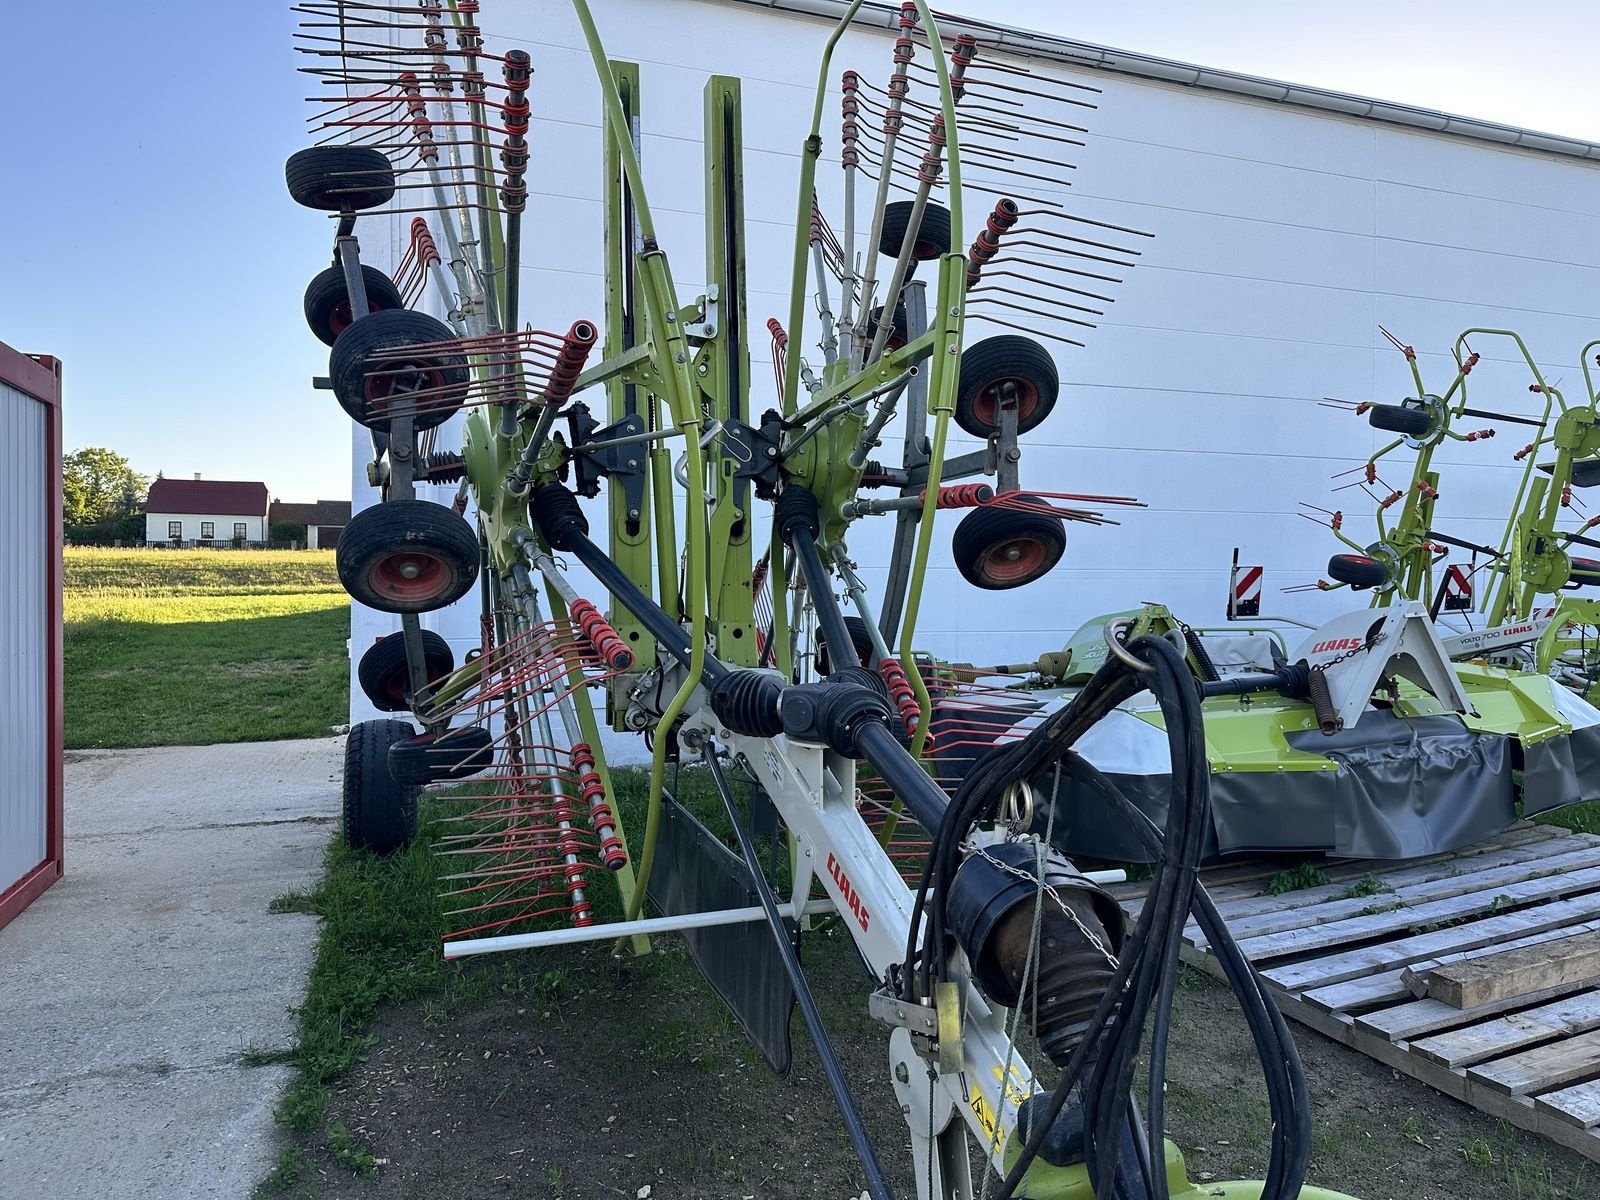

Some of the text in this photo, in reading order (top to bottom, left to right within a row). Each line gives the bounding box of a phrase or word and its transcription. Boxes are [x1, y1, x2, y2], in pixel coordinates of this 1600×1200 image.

[1460, 636, 1481, 645] VOLTO
[1482, 631, 1500, 640] 700
[1503, 625, 1533, 636] CLAAS
[1311, 637, 1362, 654] CLAAS
[827, 851, 870, 933] CLAAS
